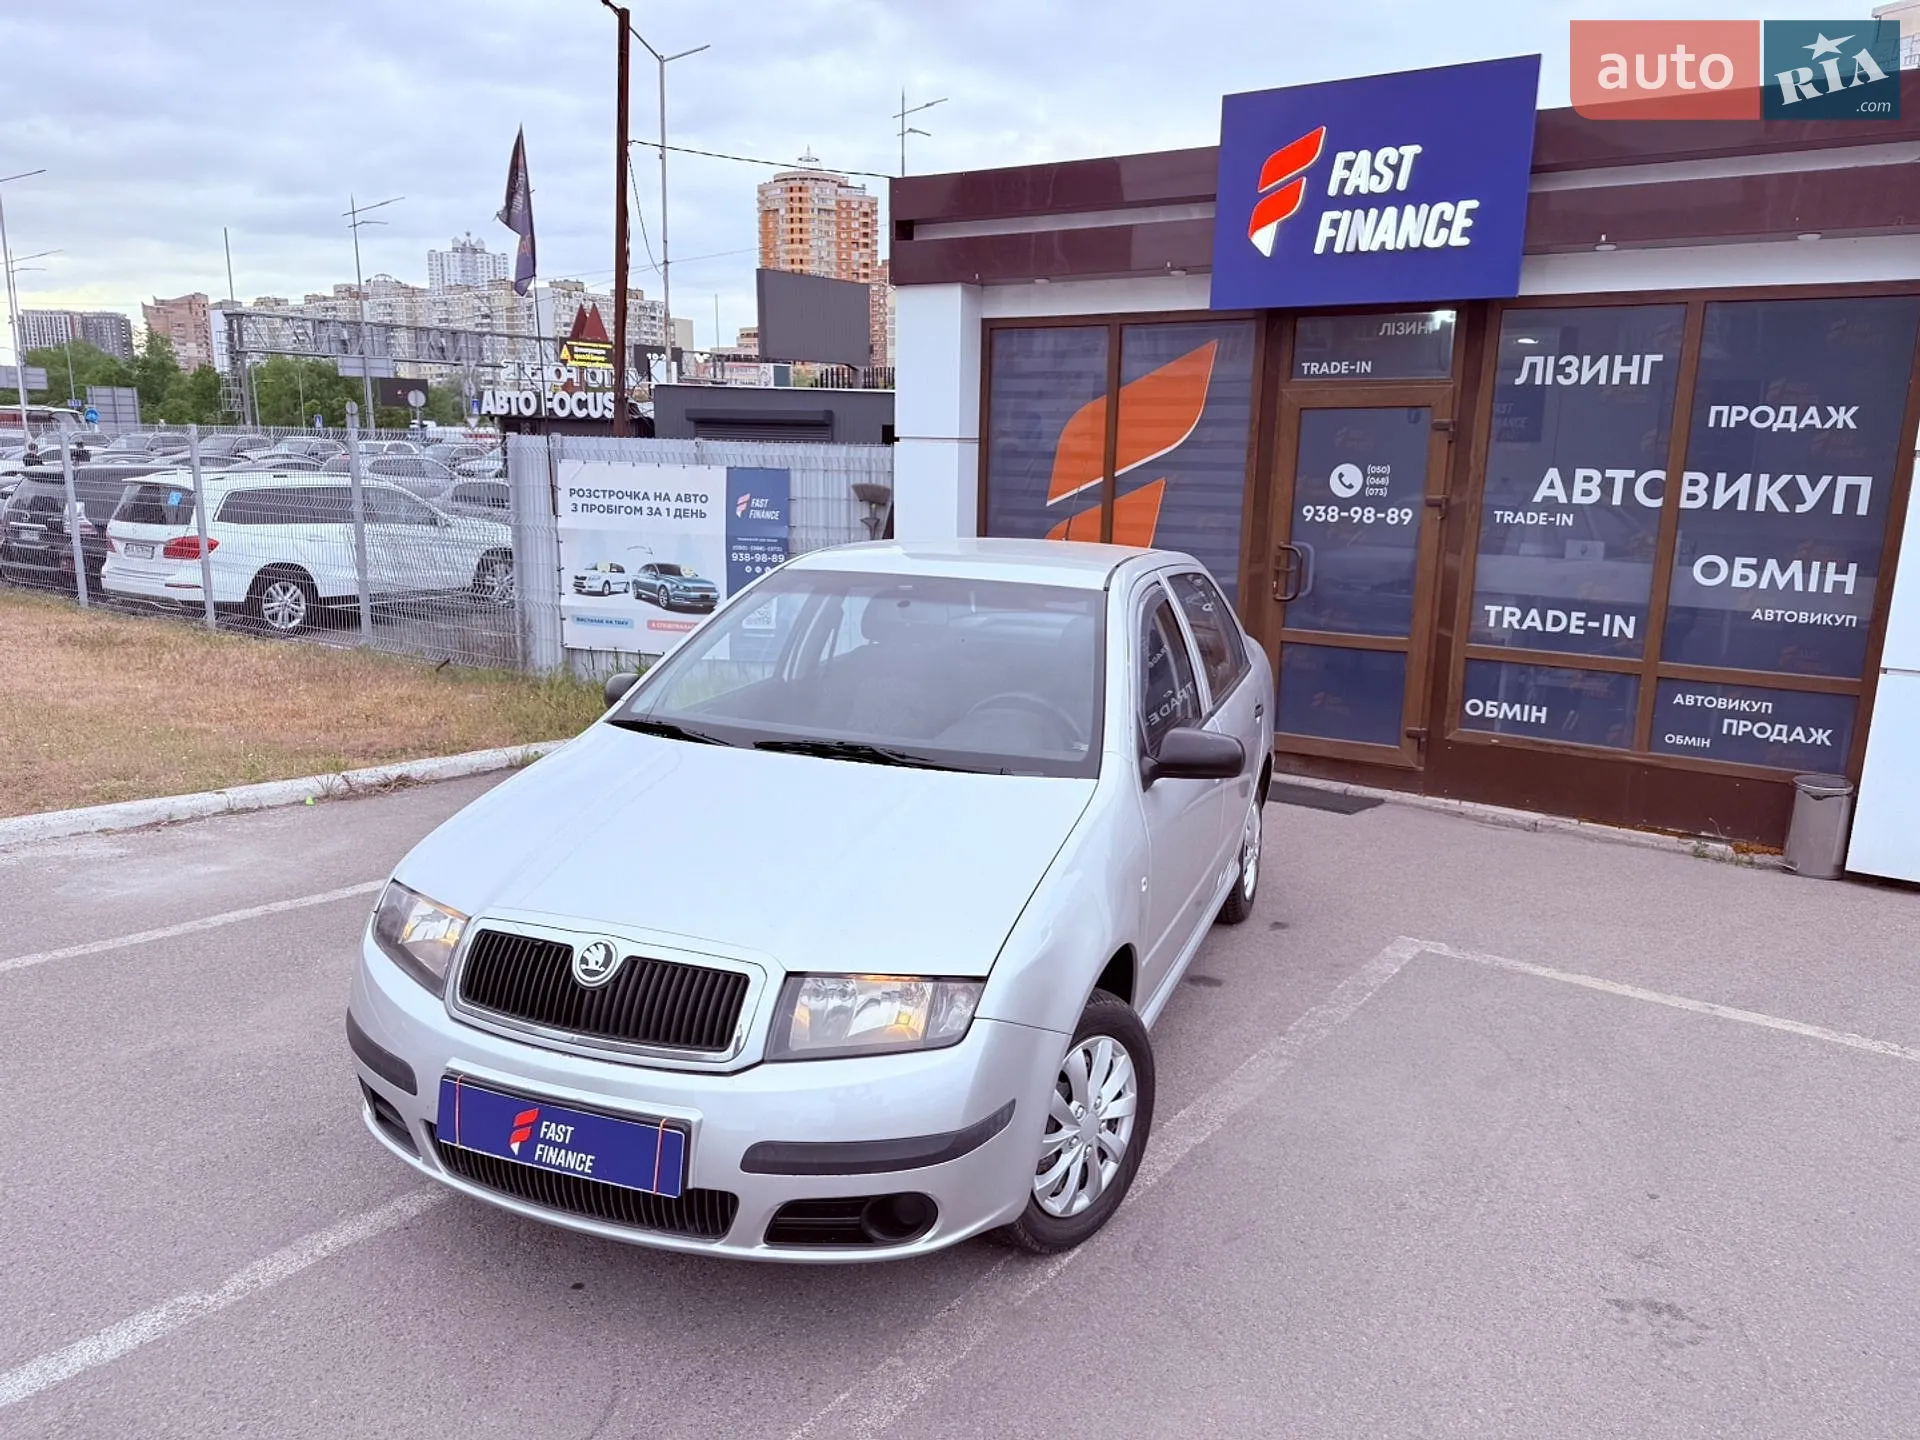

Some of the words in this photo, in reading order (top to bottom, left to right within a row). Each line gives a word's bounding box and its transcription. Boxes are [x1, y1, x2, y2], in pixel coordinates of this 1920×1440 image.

[1327, 144, 1423, 197] FAST
[1313, 199, 1480, 255] FINANCE
[1301, 360, 1373, 375] TRADE-IN
[1514, 353, 1663, 386] ЛІЗИНГ
[1707, 405, 1860, 432] ПРОДАЖ
[1367, 464, 1391, 475] (050)
[1366, 475, 1390, 486] (068)
[568, 488, 650, 501] РОЗСТРОЧКА
[653, 492, 671, 503] НА
[674, 493, 709, 504] АВТО
[1365, 486, 1388, 498] (073)
[1531, 466, 1873, 517] АВТОВИКУП
[581, 503, 643, 516] ПРОБІГОМ
[646, 507, 662, 517] ЗА
[666, 507, 671, 517] 1
[673, 508, 708, 520] ДЕНЬ
[750, 498, 769, 508] FAST
[748, 509, 780, 520] FINANCE
[1302, 505, 1413, 525] 938-98-89
[1493, 510, 1575, 527] TRADE-IN
[731, 552, 785, 563] 938-98-89
[1692, 554, 1859, 595] ОБМІН
[1484, 604, 1637, 639] TRADE-IN
[1751, 608, 1858, 628] АВТОВИКУП
[1464, 699, 1548, 724] ОБМІН
[1673, 693, 1773, 714] АВТОВИКУП
[1664, 733, 1711, 749] ОБМІН
[1721, 718, 1834, 747] ПРОДАЖ
[540, 1121, 575, 1144] FAST
[534, 1143, 596, 1174] FINANCE
